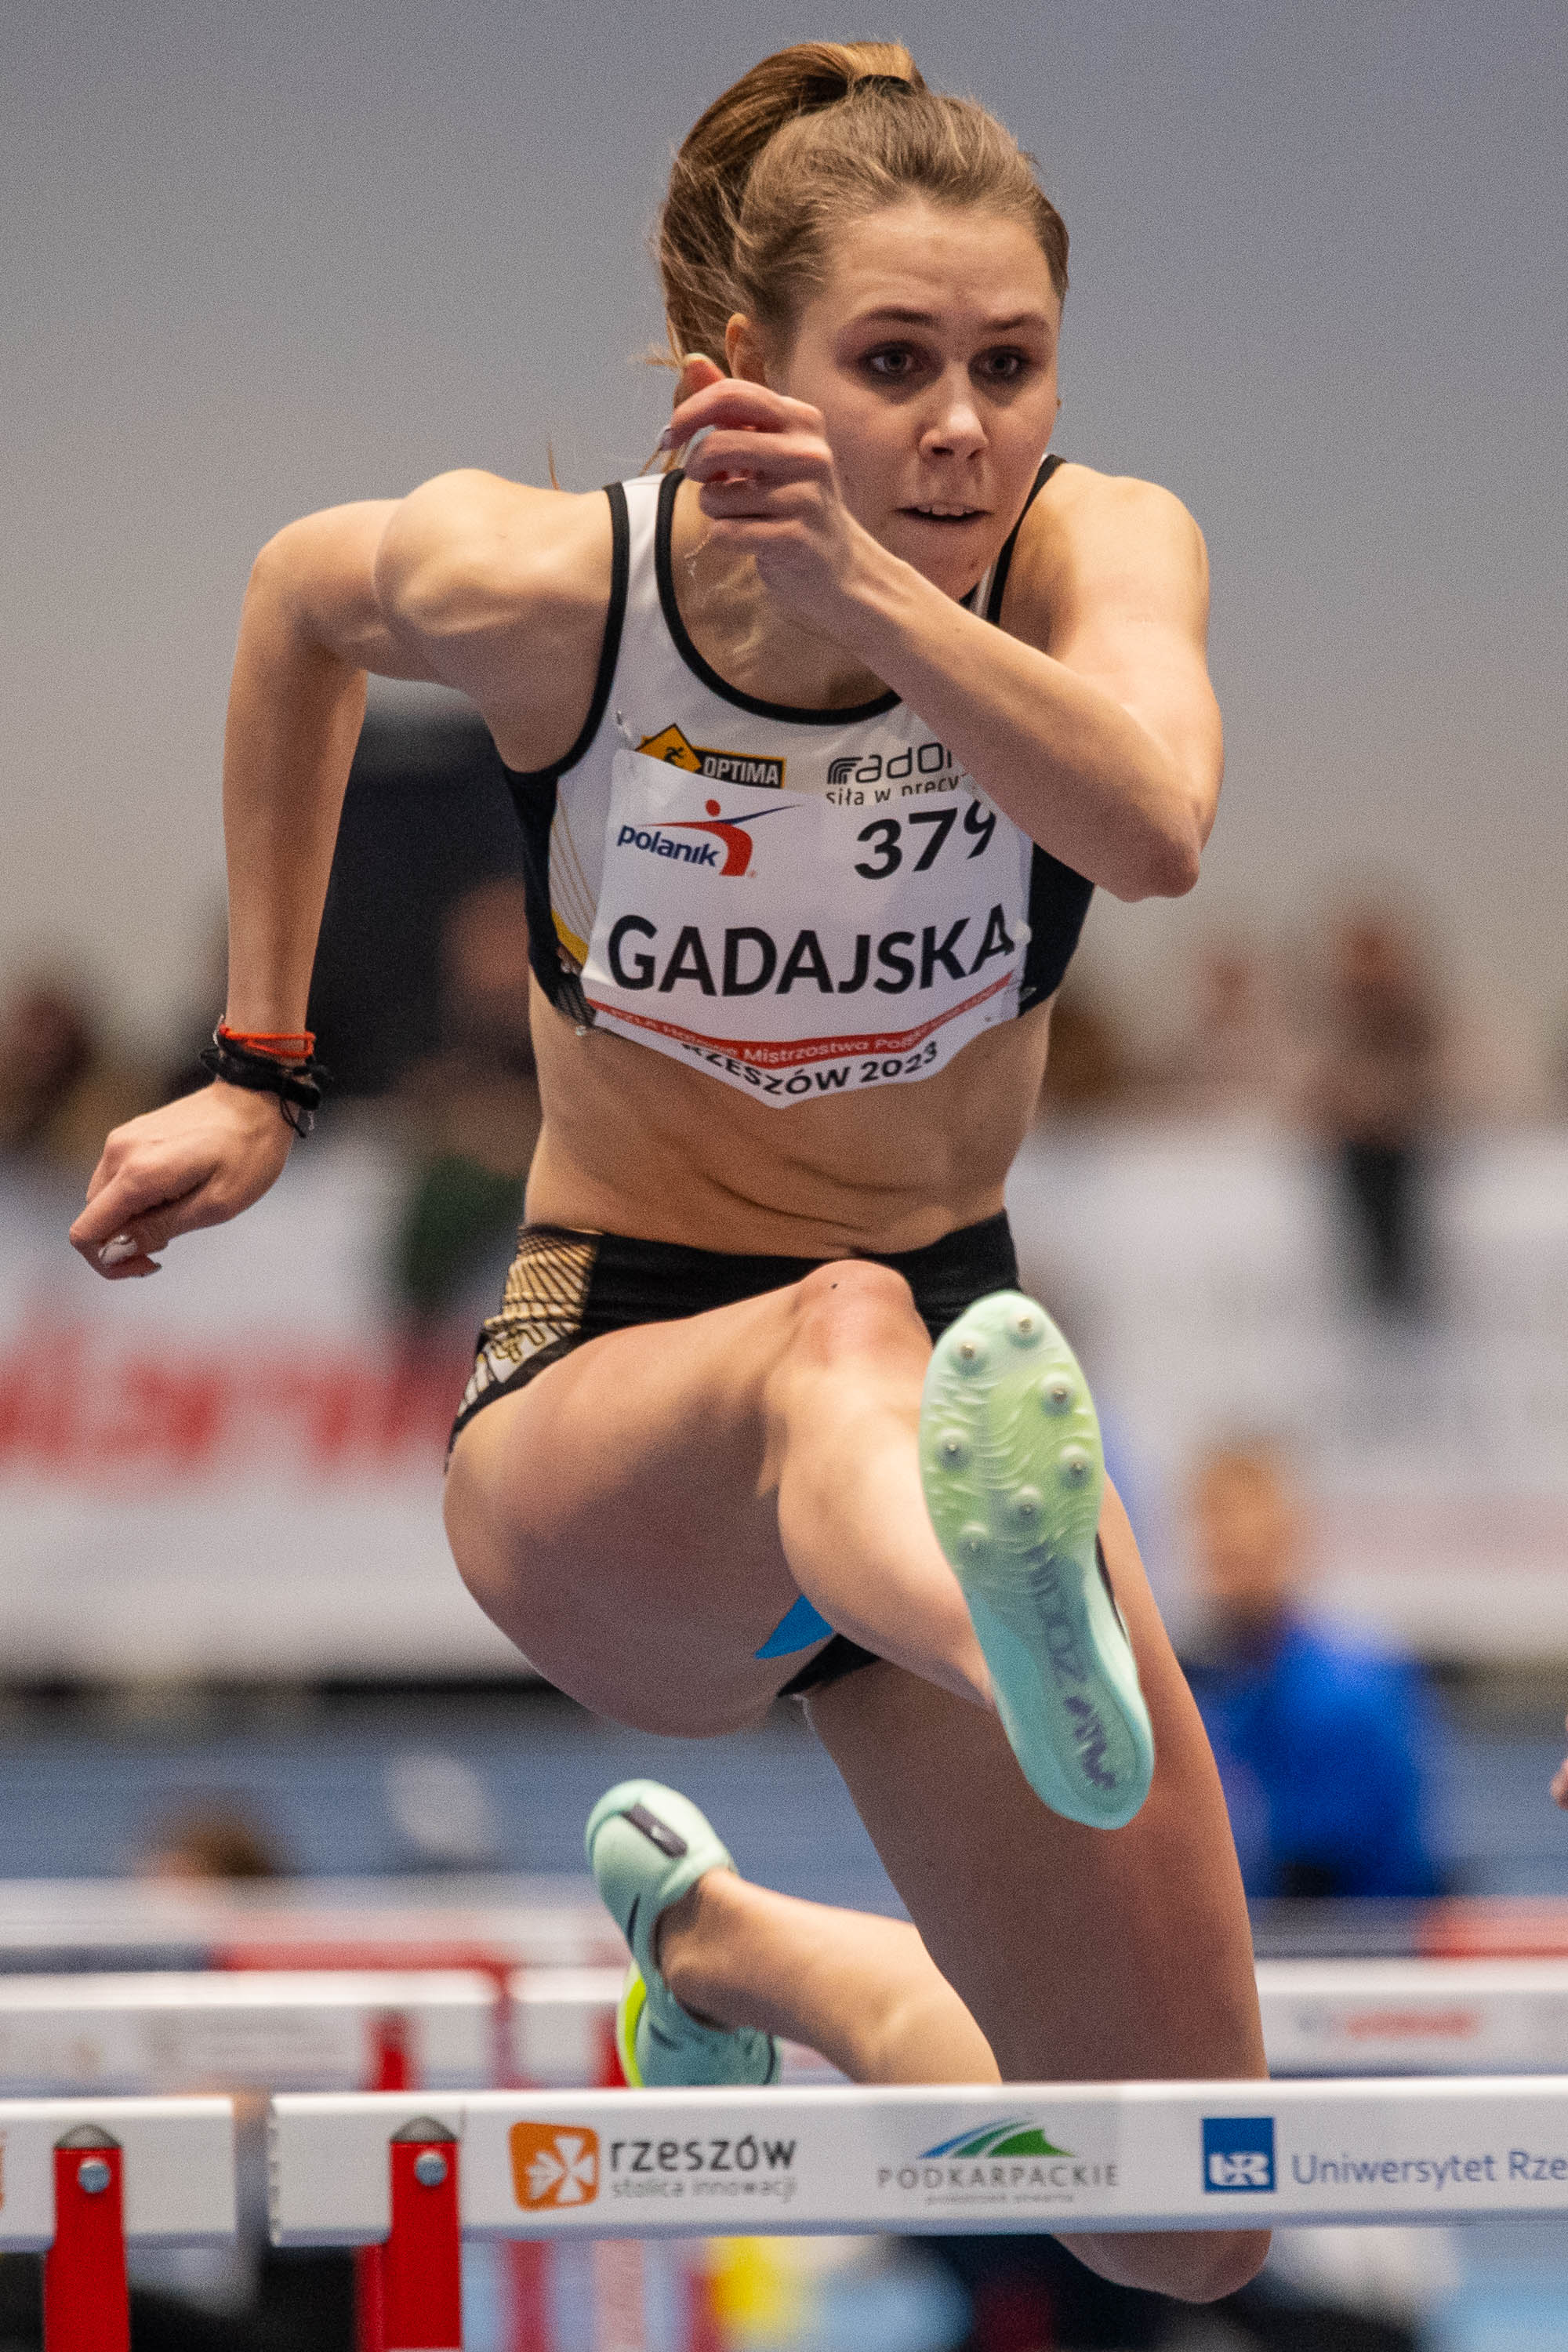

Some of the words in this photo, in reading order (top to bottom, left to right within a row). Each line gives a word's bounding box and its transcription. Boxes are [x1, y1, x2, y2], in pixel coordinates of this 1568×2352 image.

[703, 757, 779, 785] OPTIMA
[875, 787, 891, 804] w
[616, 825, 721, 867] polanik
[854, 799, 996, 880] 379
[608, 903, 1014, 996] GADAJSKA
[744, 1040, 869, 1065] Mistrzostwa
[860, 1040, 938, 1083] 2023
[610, 2134, 797, 2172] rzeszów
[1290, 2151, 1496, 2191] Uniwersytet
[877, 2162, 1118, 2189] PODKARPACKIE
